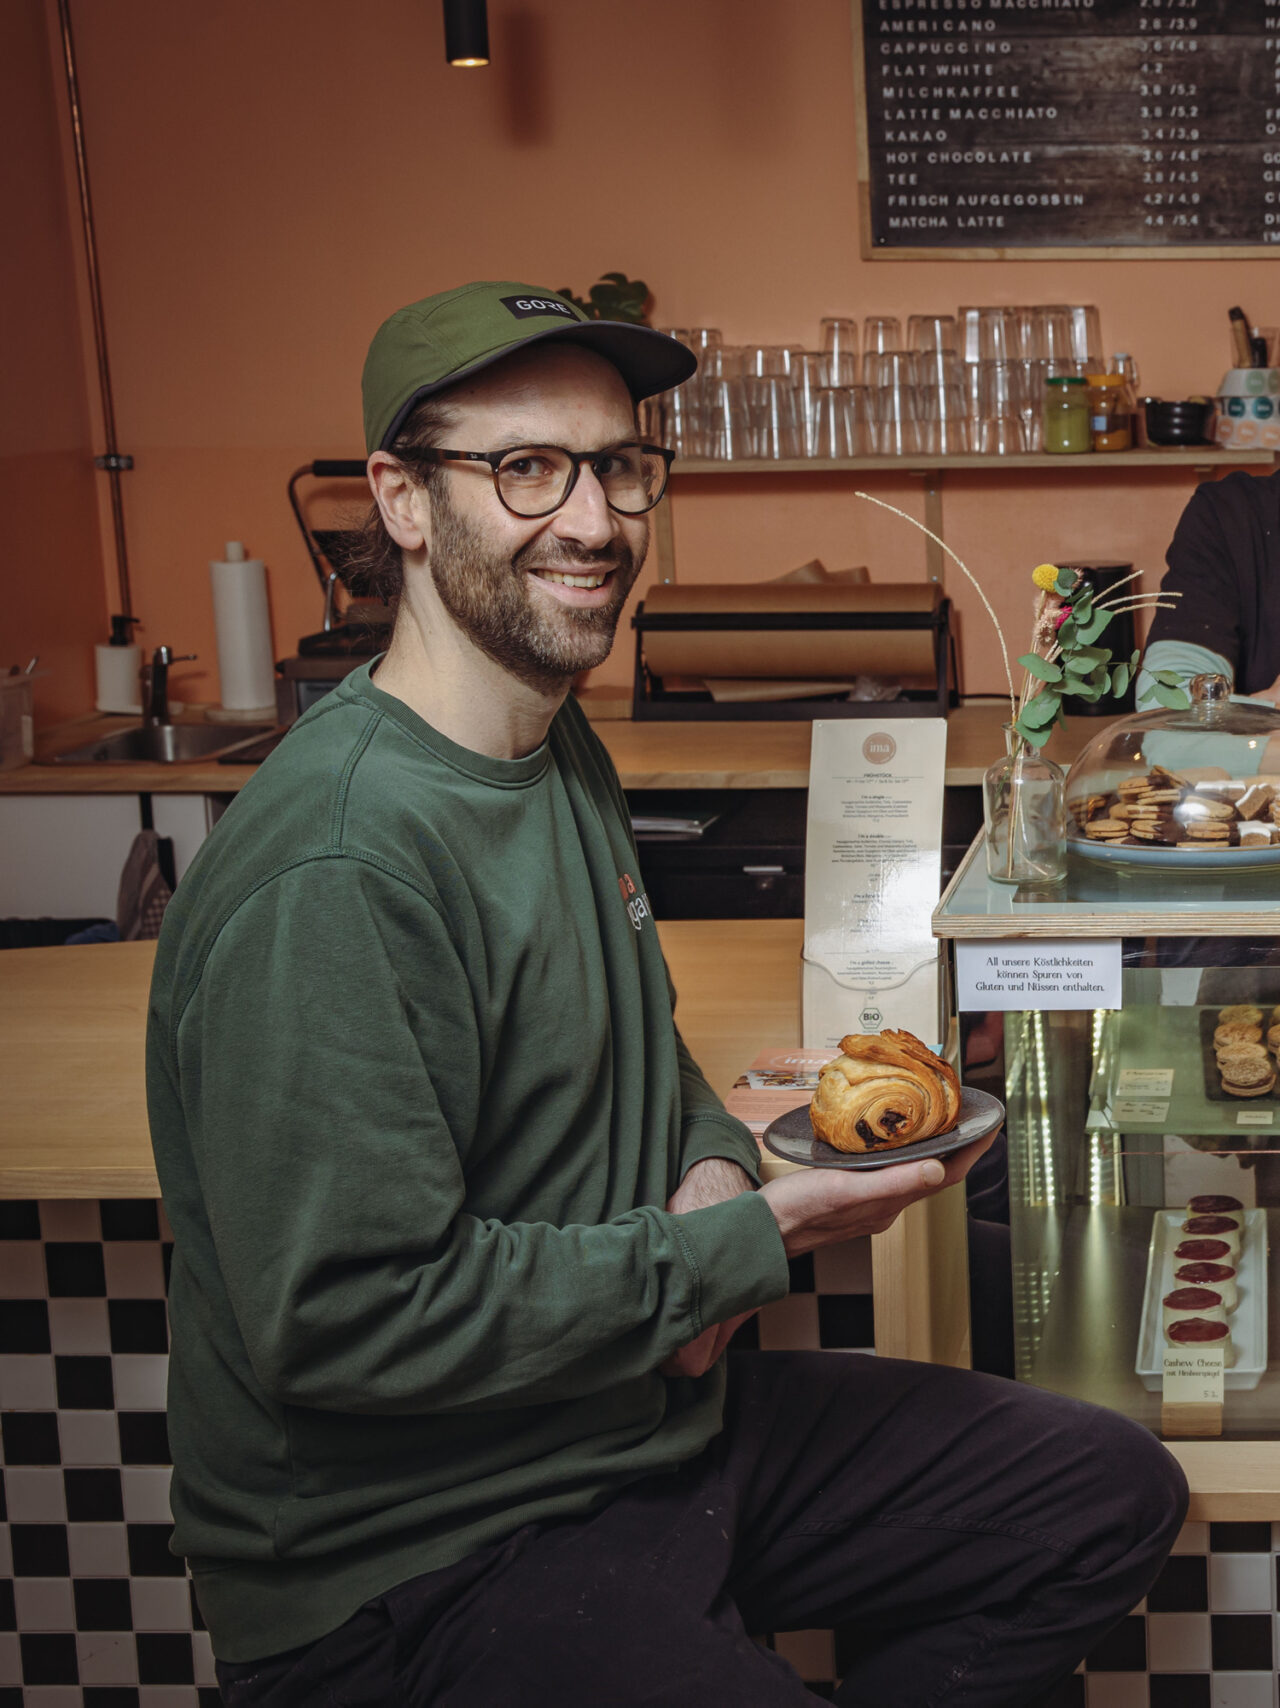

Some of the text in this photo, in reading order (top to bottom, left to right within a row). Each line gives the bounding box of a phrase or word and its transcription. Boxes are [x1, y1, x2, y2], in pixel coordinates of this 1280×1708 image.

[880, 19, 997, 33] AMERICANO
[880, 41, 1012, 55] CAPPUCCINO
[882, 64, 926, 77] FLAT
[936, 63, 994, 77] WHITE
[882, 85, 1020, 99] MILCHKAFFEE
[884, 108, 941, 121] LATTE
[950, 107, 1058, 120] MACCHIATO
[885, 129, 948, 142] KAKAO
[886, 151, 918, 164] HOT
[927, 150, 1032, 164] CHOCOLATE
[888, 174, 918, 186] TEE
[888, 194, 948, 207] FRISCH
[956, 194, 1084, 207] AUFGEGOSSEN
[889, 216, 948, 229] MATCHA
[957, 216, 1005, 228] LATTE
[515, 299, 571, 314] GORE
[986, 956, 1094, 967] All unsere Köstlichkeiten
[996, 969, 1029, 979] können
[1032, 970, 1063, 981] Spuren
[975, 981, 1105, 992] Gluten und Nüssen enthalten.
[1163, 1358, 1222, 1367] Cashew Cheese
